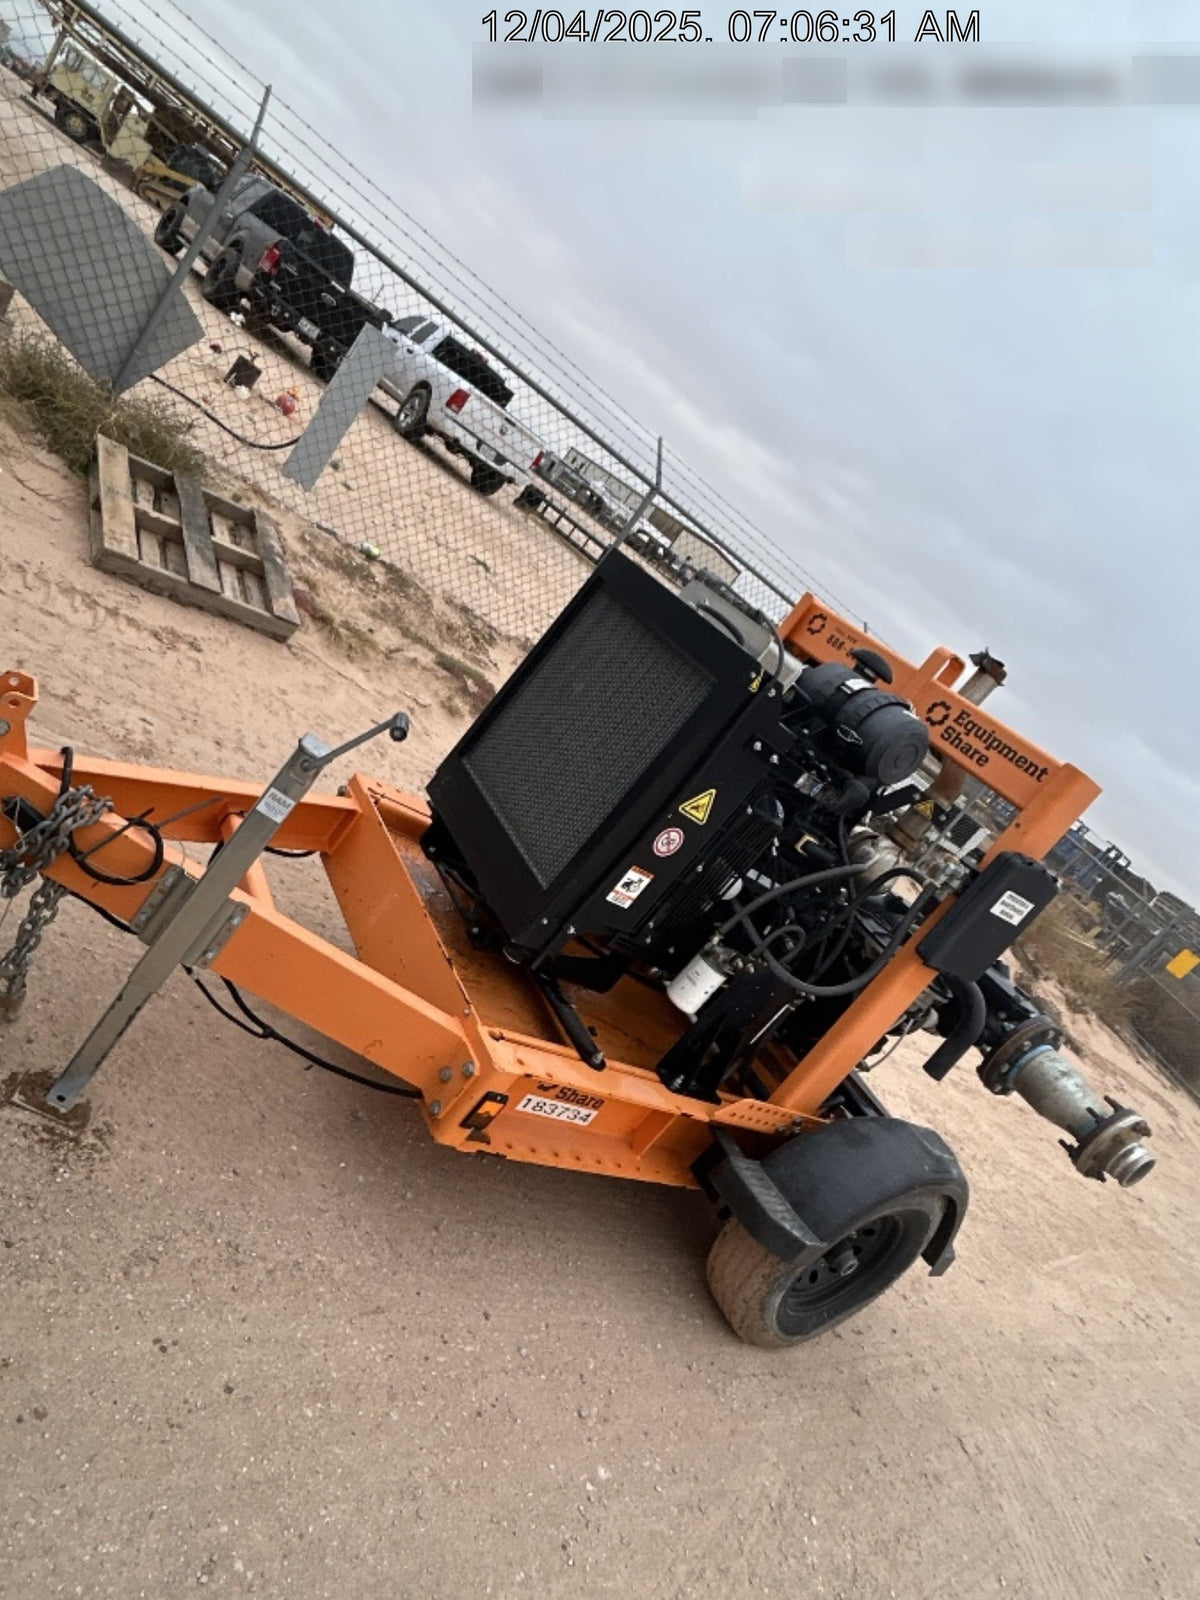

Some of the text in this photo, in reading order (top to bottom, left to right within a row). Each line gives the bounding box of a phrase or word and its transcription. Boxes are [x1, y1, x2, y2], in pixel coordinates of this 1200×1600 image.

[940, 725, 990, 767] Share
[953, 709, 1049, 783] Equipment
[522, 1098, 592, 1123] 183734
[555, 1086, 606, 1110] Share
